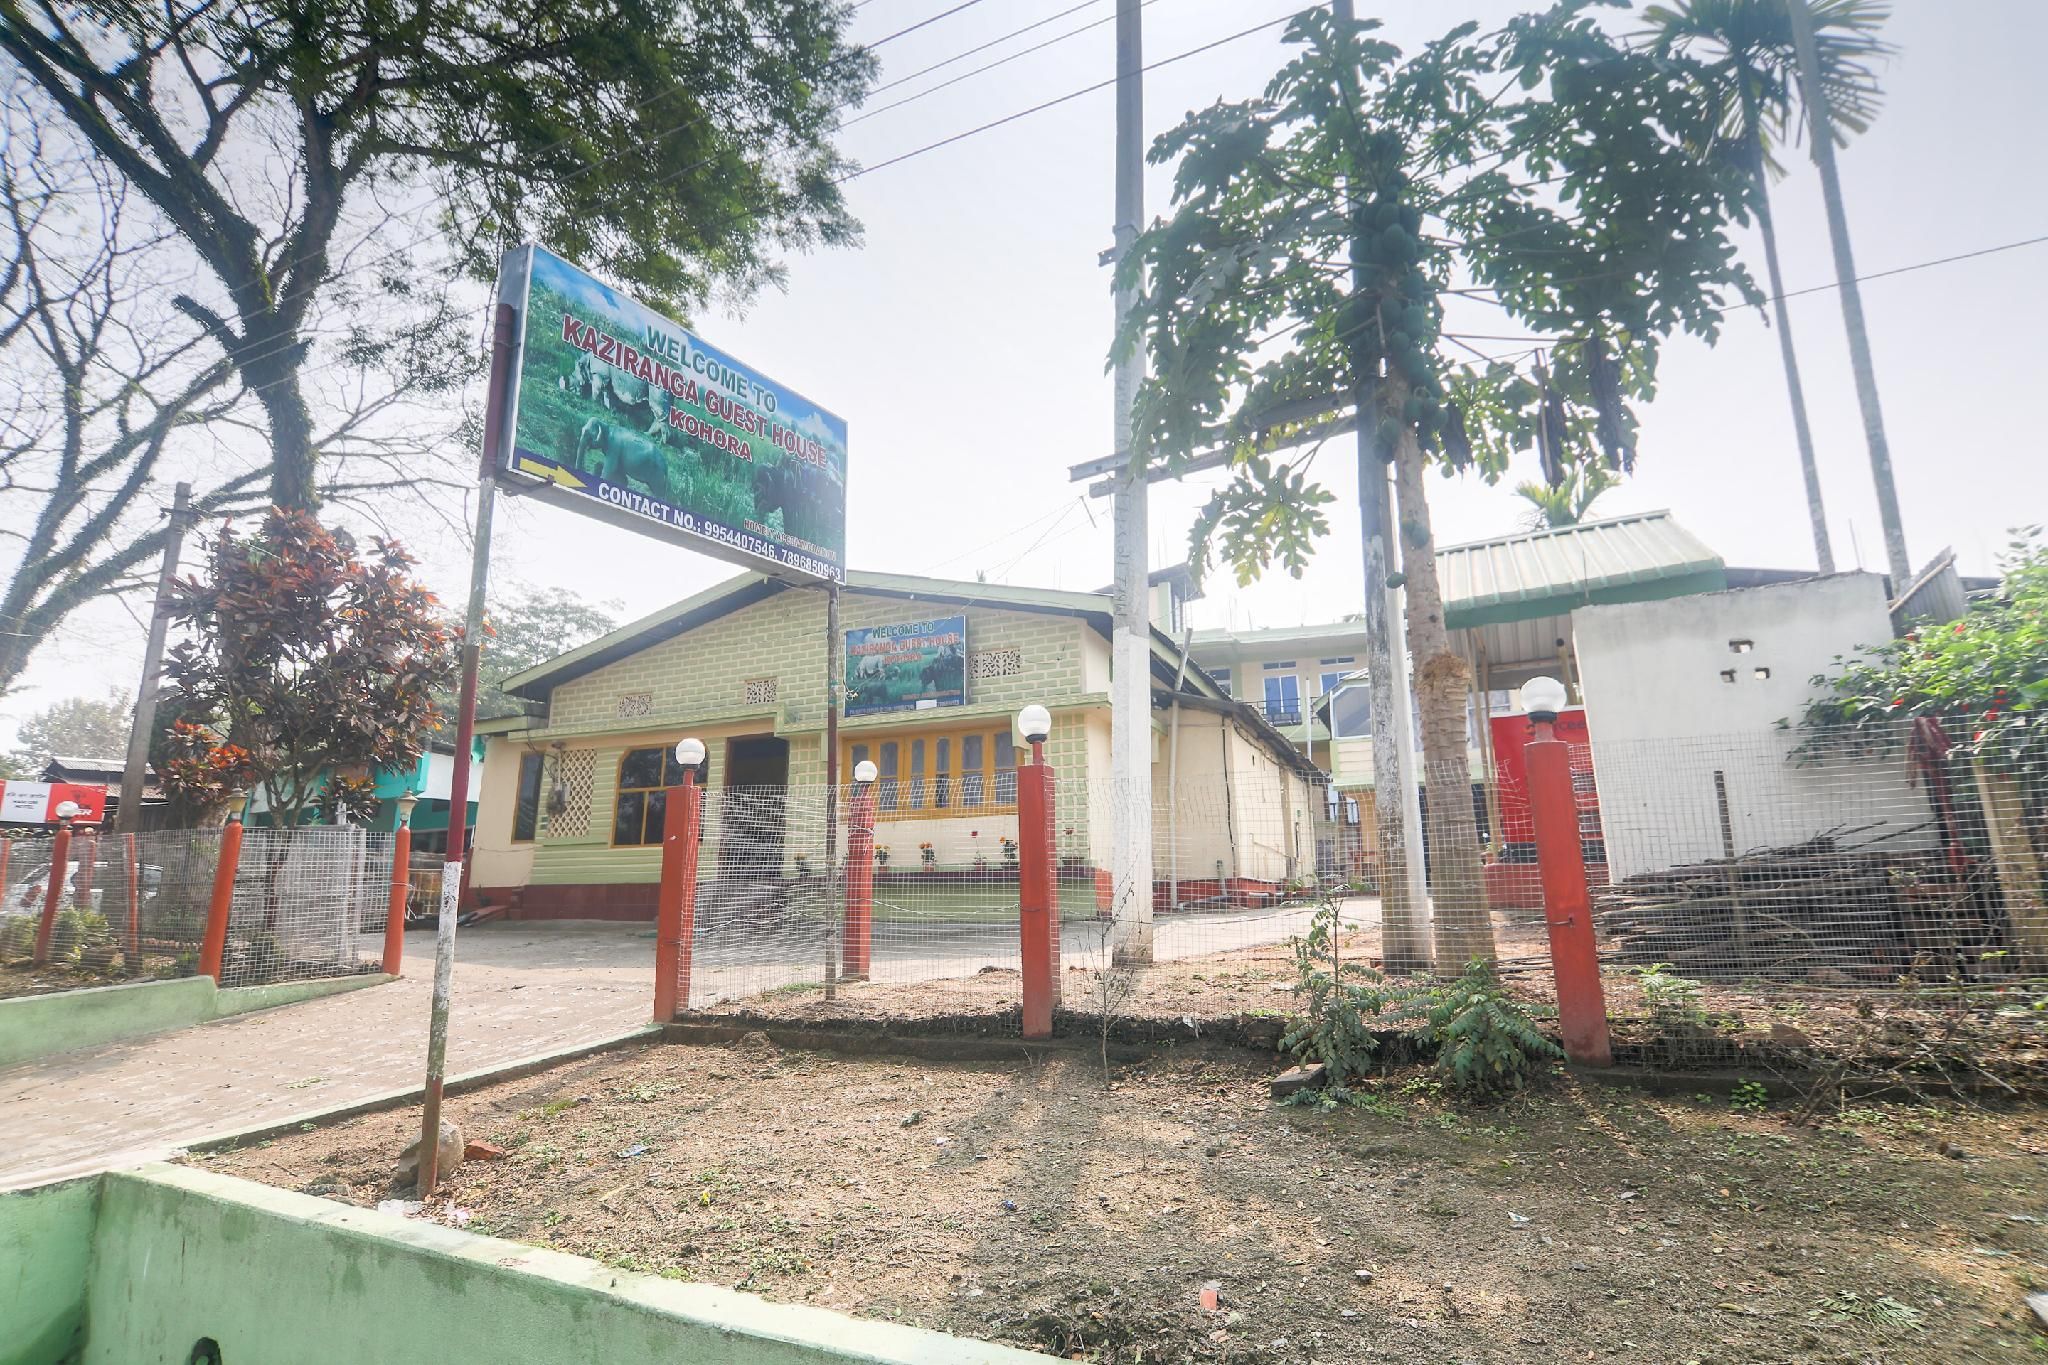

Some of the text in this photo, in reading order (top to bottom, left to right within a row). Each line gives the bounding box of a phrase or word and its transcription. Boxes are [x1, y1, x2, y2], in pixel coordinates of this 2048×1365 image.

[562, 313, 828, 468] KAZIRANGA GUEST HOUSE
[646, 325, 777, 412] WELCOME TO
[669, 406, 752, 462] KOHORA
[598, 482, 670, 522] CONTACT
[704, 521, 778, 560] 9954407546,
[781, 548, 841, 580] 7896850963
[872, 622, 934, 638] WELCOME TO
